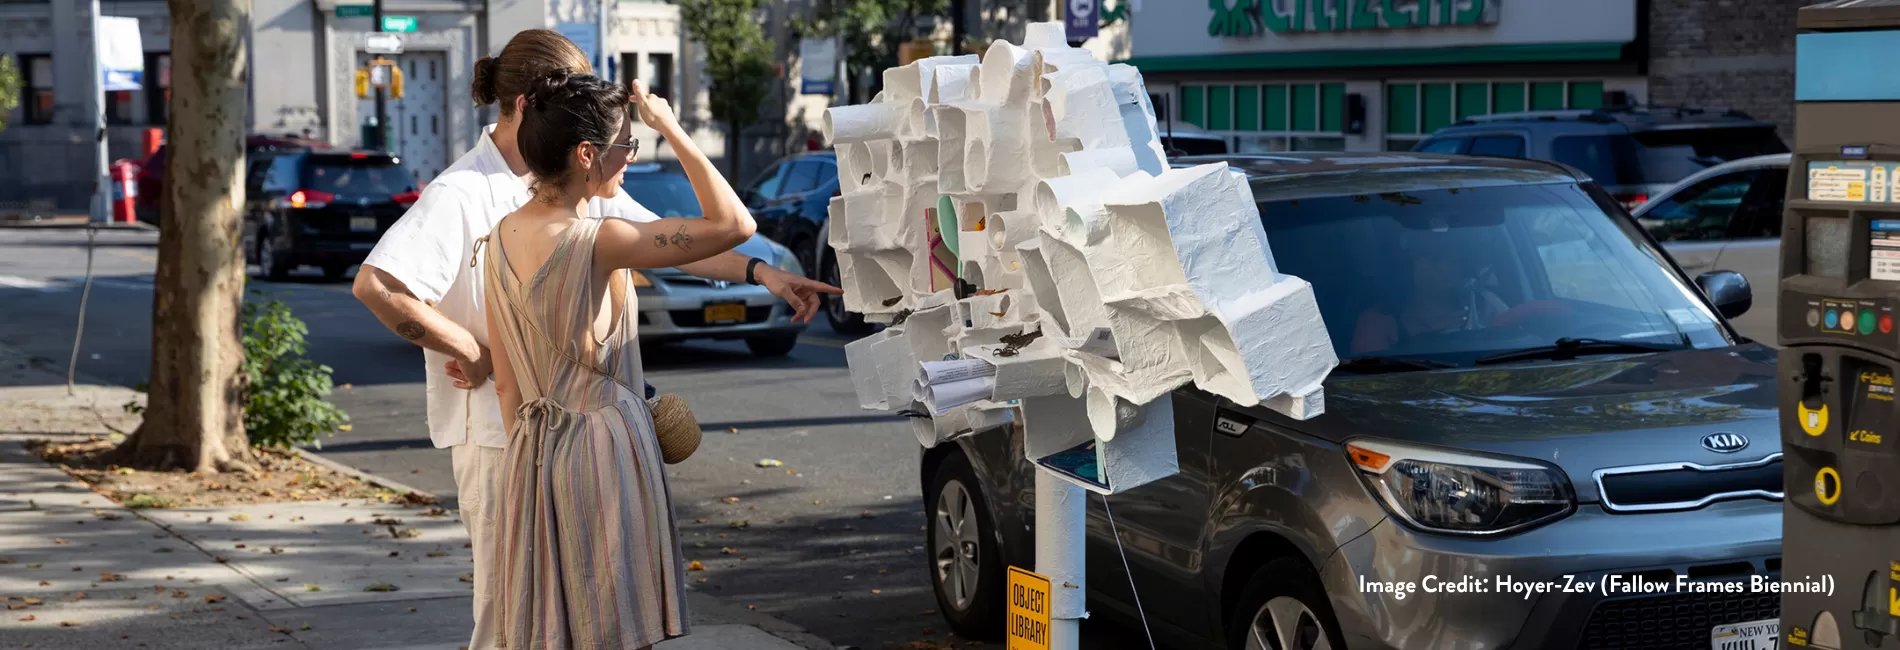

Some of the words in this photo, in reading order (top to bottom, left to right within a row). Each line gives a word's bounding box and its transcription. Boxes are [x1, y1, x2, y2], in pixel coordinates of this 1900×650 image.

[1707, 434, 1743, 448] KIA
[1860, 430, 1881, 444] Coins
[1013, 583, 1045, 615] OBJECT
[1011, 612, 1047, 646] LIBRARY
[1739, 626, 1764, 638] NEW
[1766, 624, 1780, 635] YO
